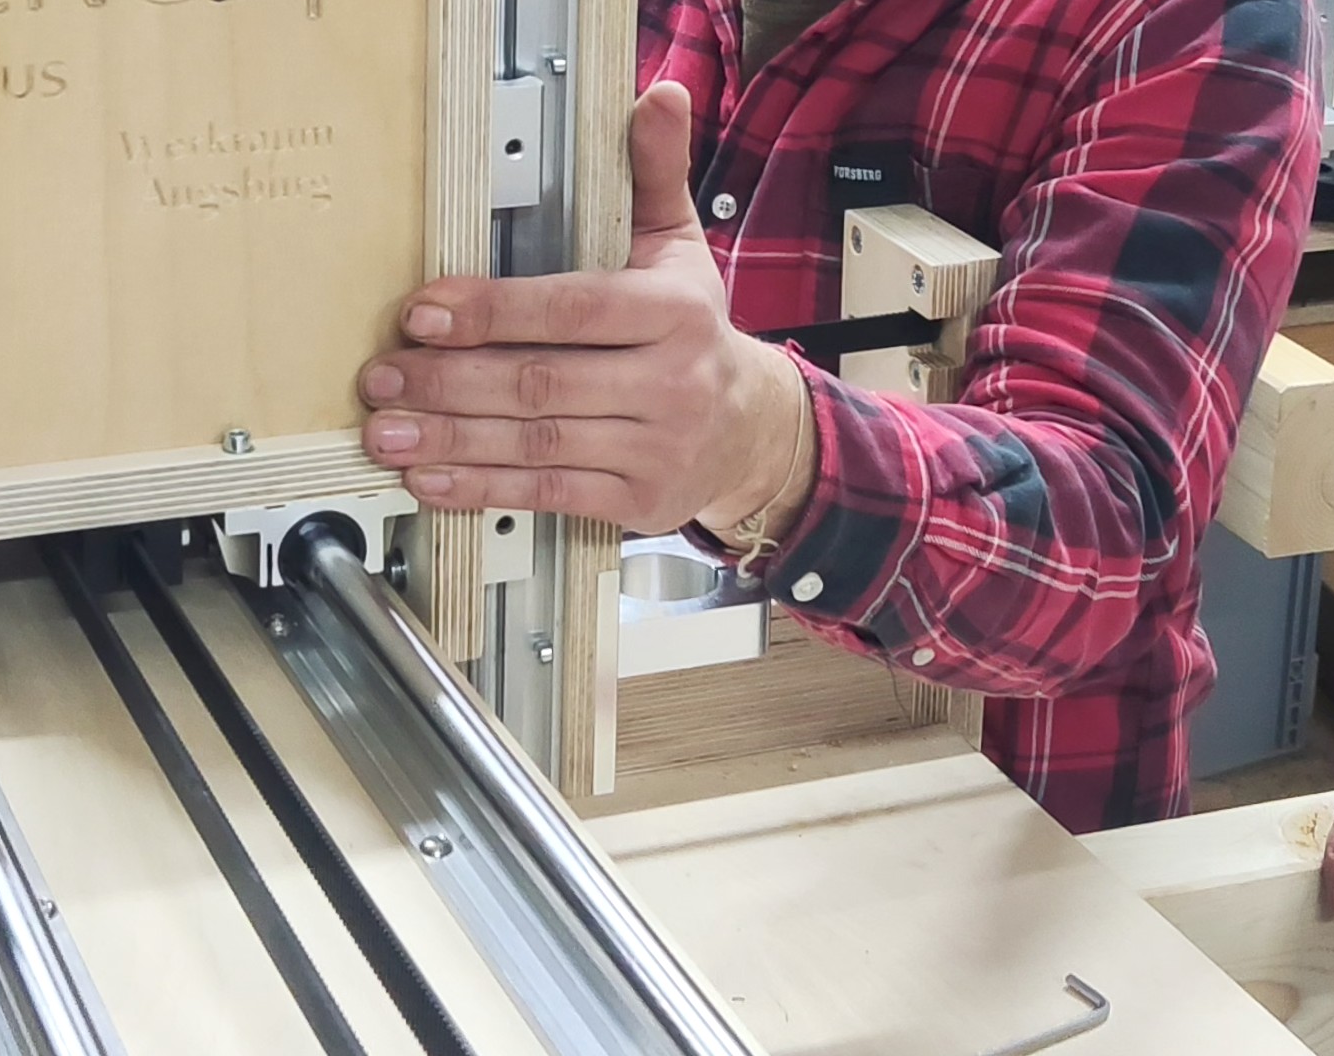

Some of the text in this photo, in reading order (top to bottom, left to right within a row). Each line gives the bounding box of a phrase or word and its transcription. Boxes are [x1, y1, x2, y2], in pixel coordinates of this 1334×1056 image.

[119, 121, 334, 163] Werkraum
[144, 165, 333, 221] Augsburg
[833, 165, 882, 181] FORSBERG
